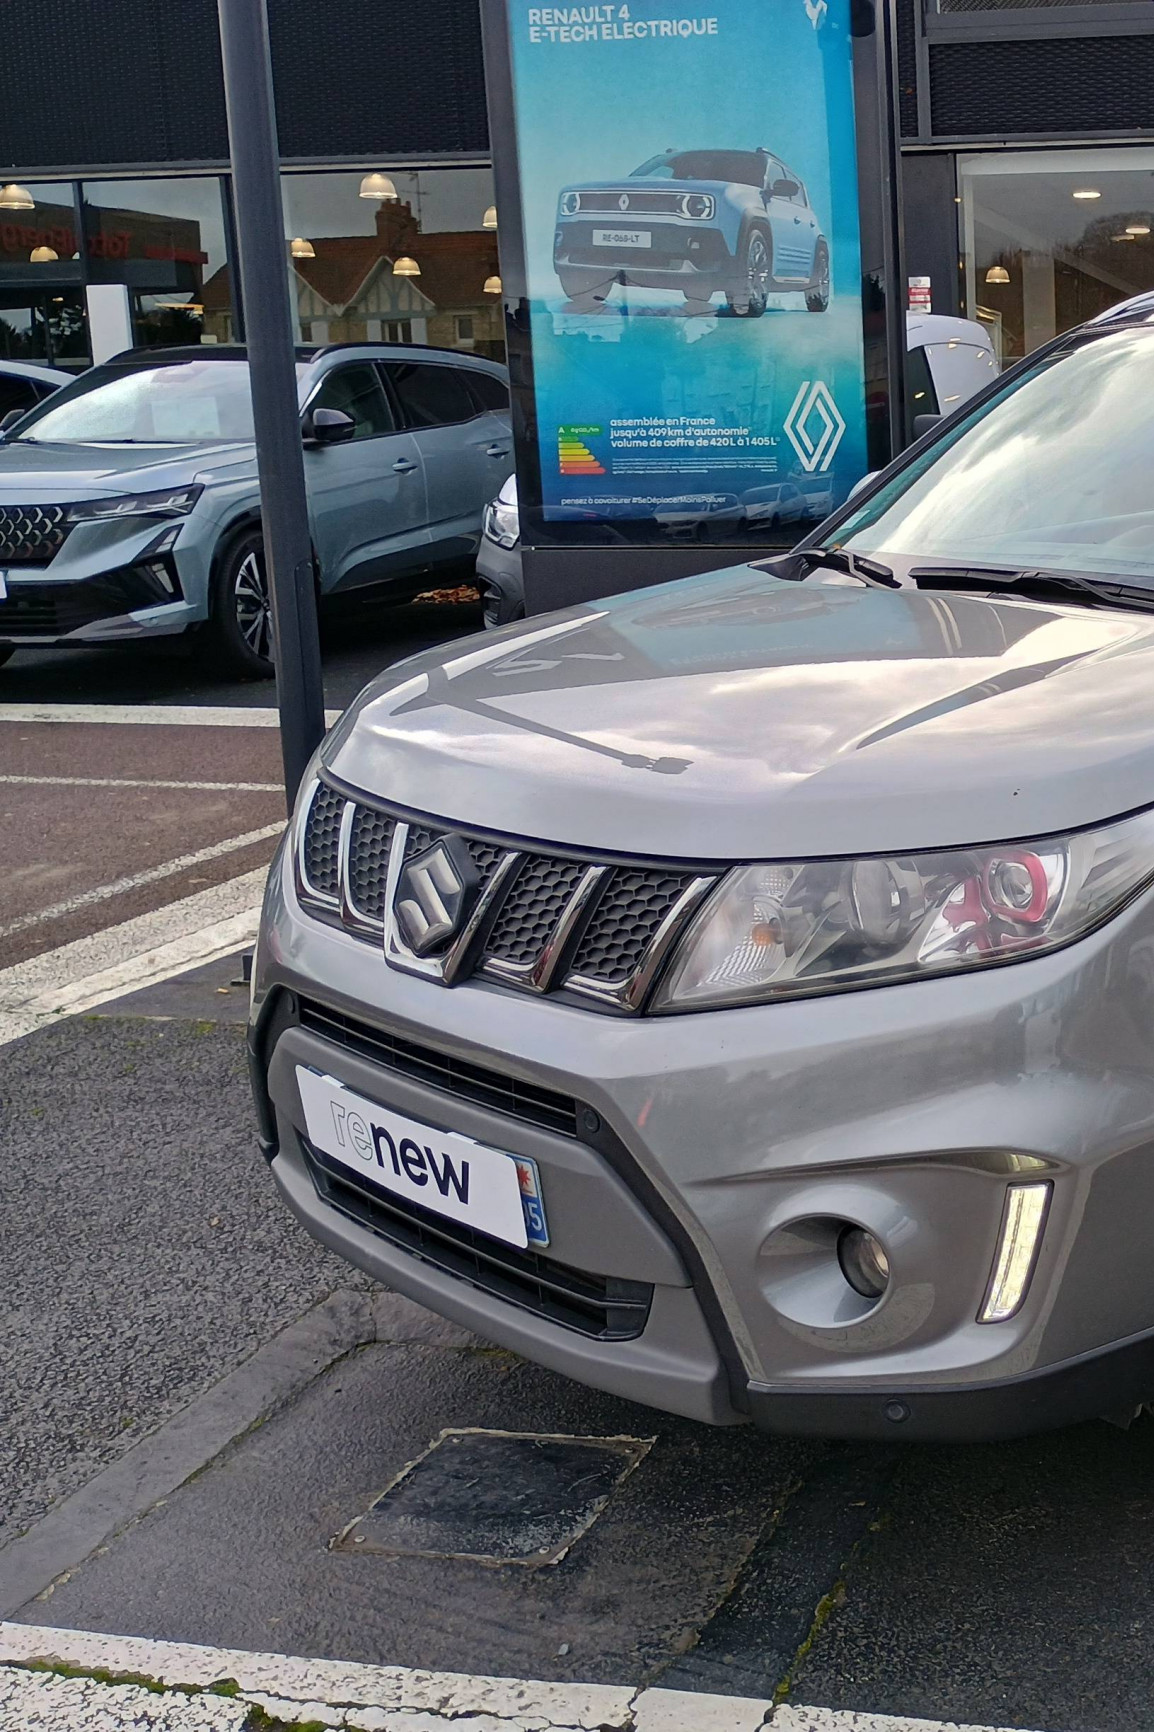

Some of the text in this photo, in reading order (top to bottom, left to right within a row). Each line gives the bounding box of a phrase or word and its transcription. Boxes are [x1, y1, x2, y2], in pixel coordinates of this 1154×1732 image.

[528, 4, 631, 25] RENAULT 4
[529, 17, 719, 43] E-TECH ELECTRIQUE
[609, 416, 716, 426] assemblée en France
[647, 427, 667, 437] 409
[667, 427, 684, 437] km
[611, 438, 648, 448] volume
[649, 438, 662, 447] de
[663, 437, 695, 447] coffre
[695, 437, 709, 447] de
[737, 436, 744, 446] à
[560, 498, 588, 506] pensez
[329, 1100, 470, 1205] renew
